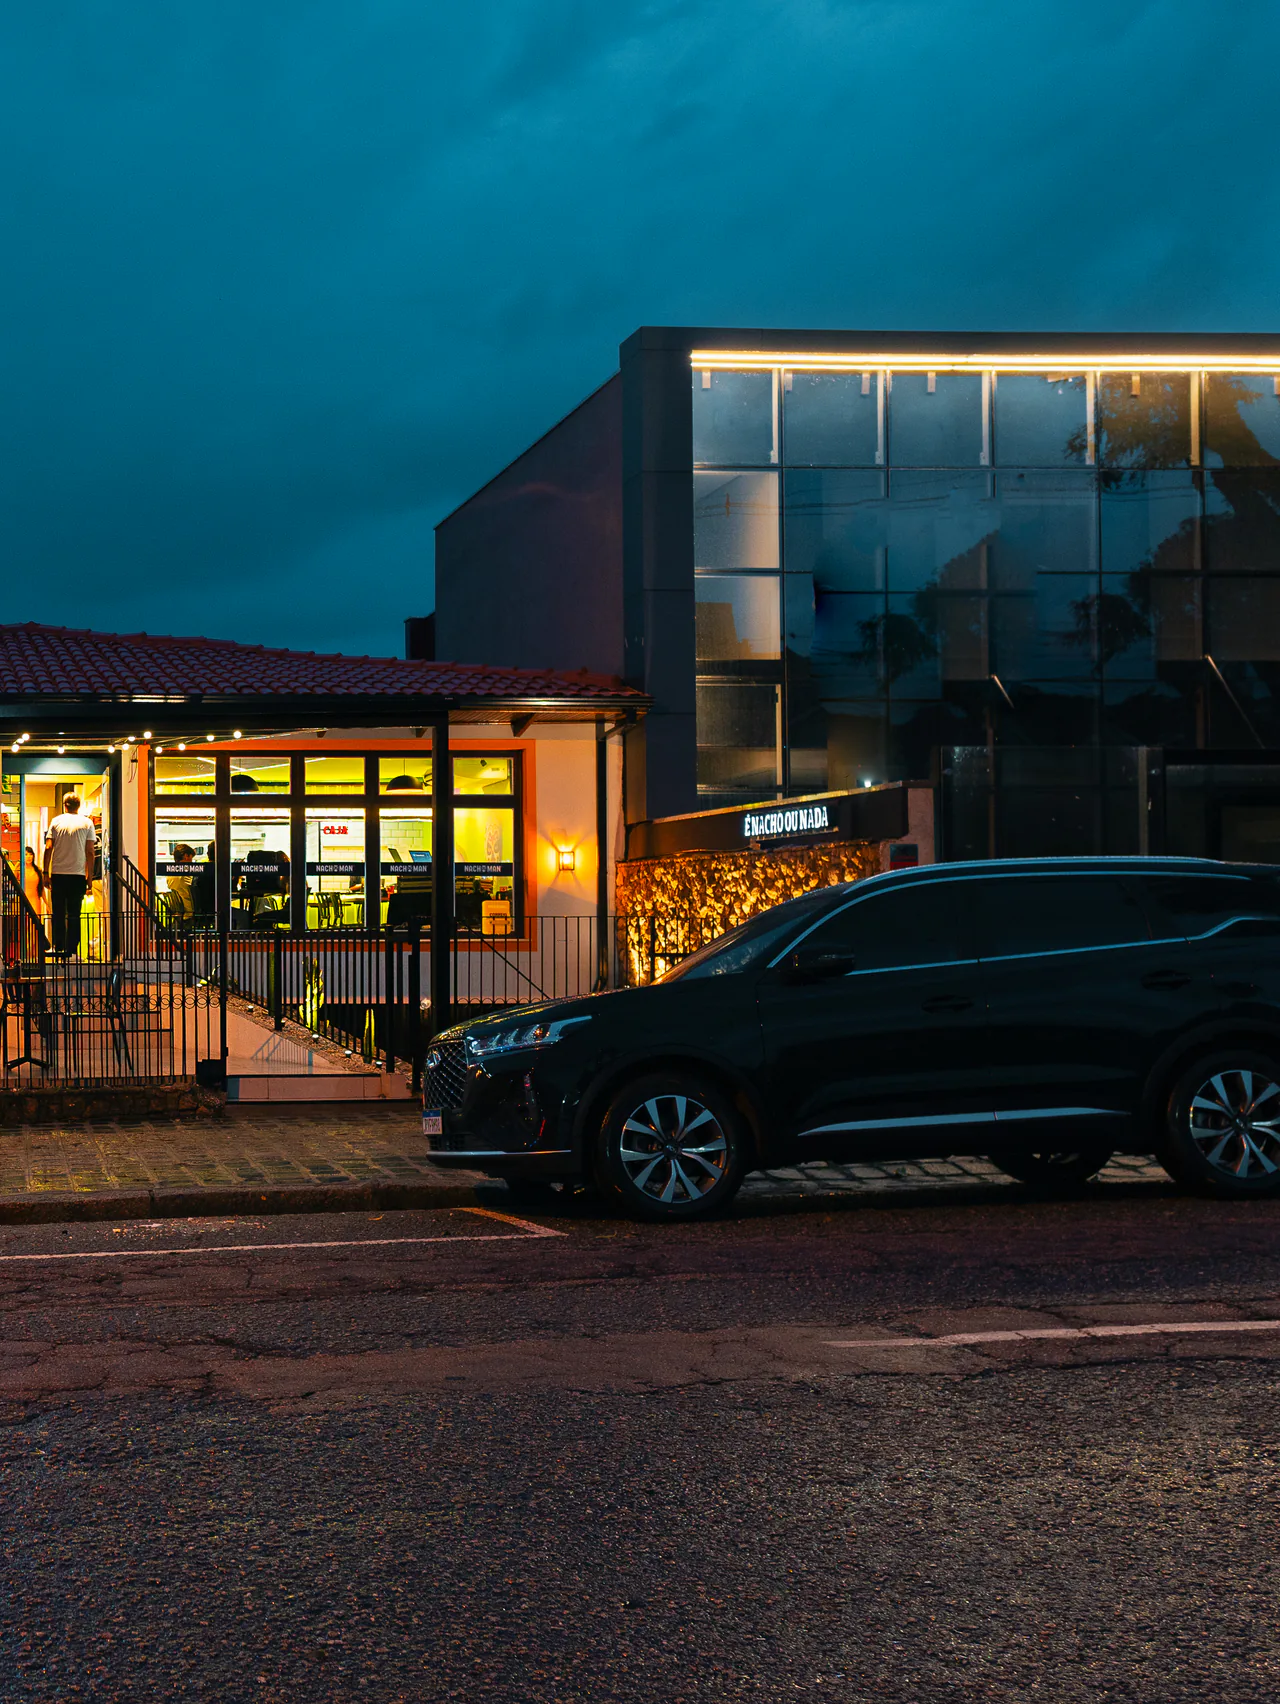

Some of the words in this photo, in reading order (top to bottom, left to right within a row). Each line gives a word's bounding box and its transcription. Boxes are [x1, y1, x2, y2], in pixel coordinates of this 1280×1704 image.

[323, 825, 348, 835] CAJA
[751, 813, 784, 836] NACHO
[784, 810, 798, 832] OU
[799, 806, 829, 830] NADA
